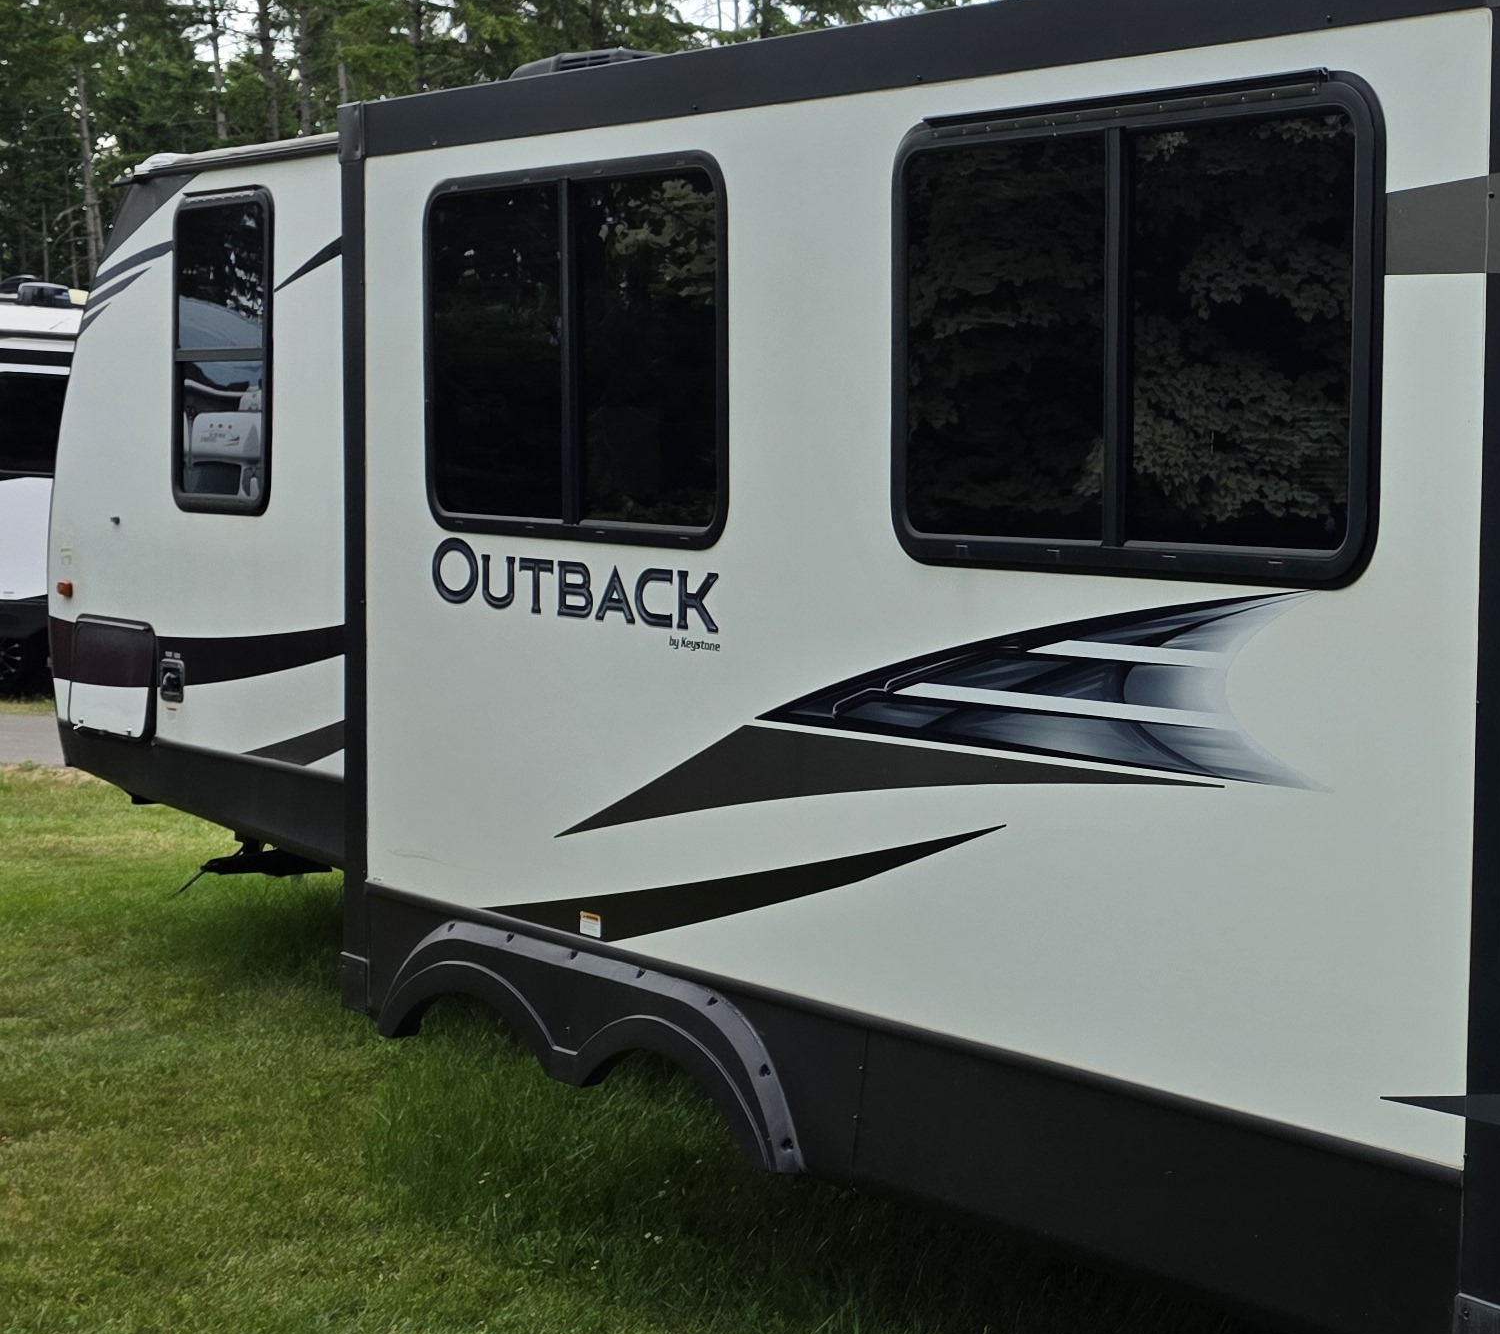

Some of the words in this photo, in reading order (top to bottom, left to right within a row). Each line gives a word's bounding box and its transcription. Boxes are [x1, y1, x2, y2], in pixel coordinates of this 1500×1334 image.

[432, 537, 719, 633] OUTBACK
[669, 635, 679, 649] by
[681, 637, 720, 651] Keystone
